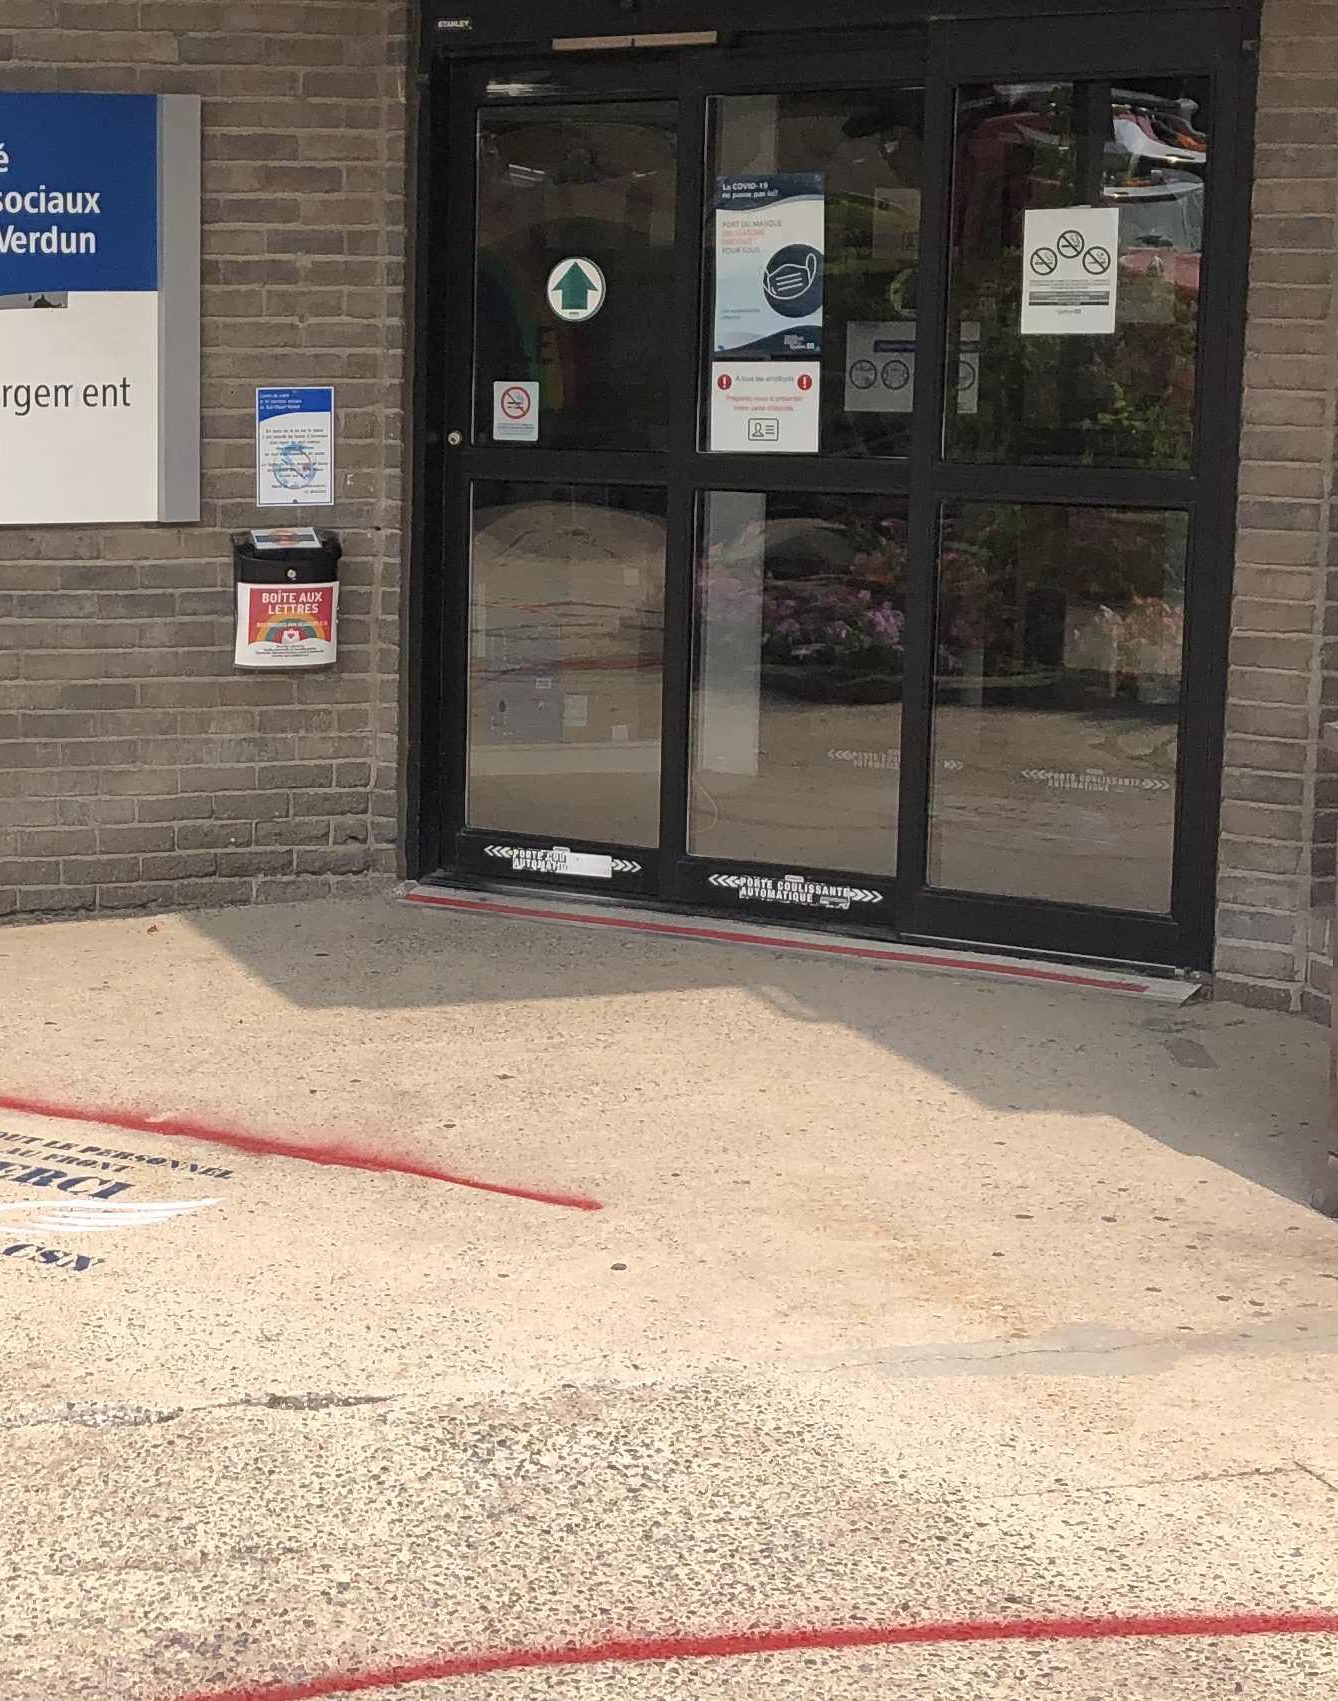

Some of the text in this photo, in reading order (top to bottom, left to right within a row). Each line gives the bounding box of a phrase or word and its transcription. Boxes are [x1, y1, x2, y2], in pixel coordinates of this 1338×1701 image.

[438, 20, 471, 28] STANLEY
[262, 590, 323, 603] BOÎTE AUX
[268, 604, 319, 615] LETTRES
[513, 849, 543, 860] PORTE
[740, 877, 773, 889] PORTE
[778, 881, 850, 897] COULISSANTE
[741, 887, 813, 902] AUTOMATIQUE
[0, 1147, 134, 1173] AU FRONT
[42, 1140, 79, 1151] LE
[78, 1145, 234, 1179] PERSONNEL
